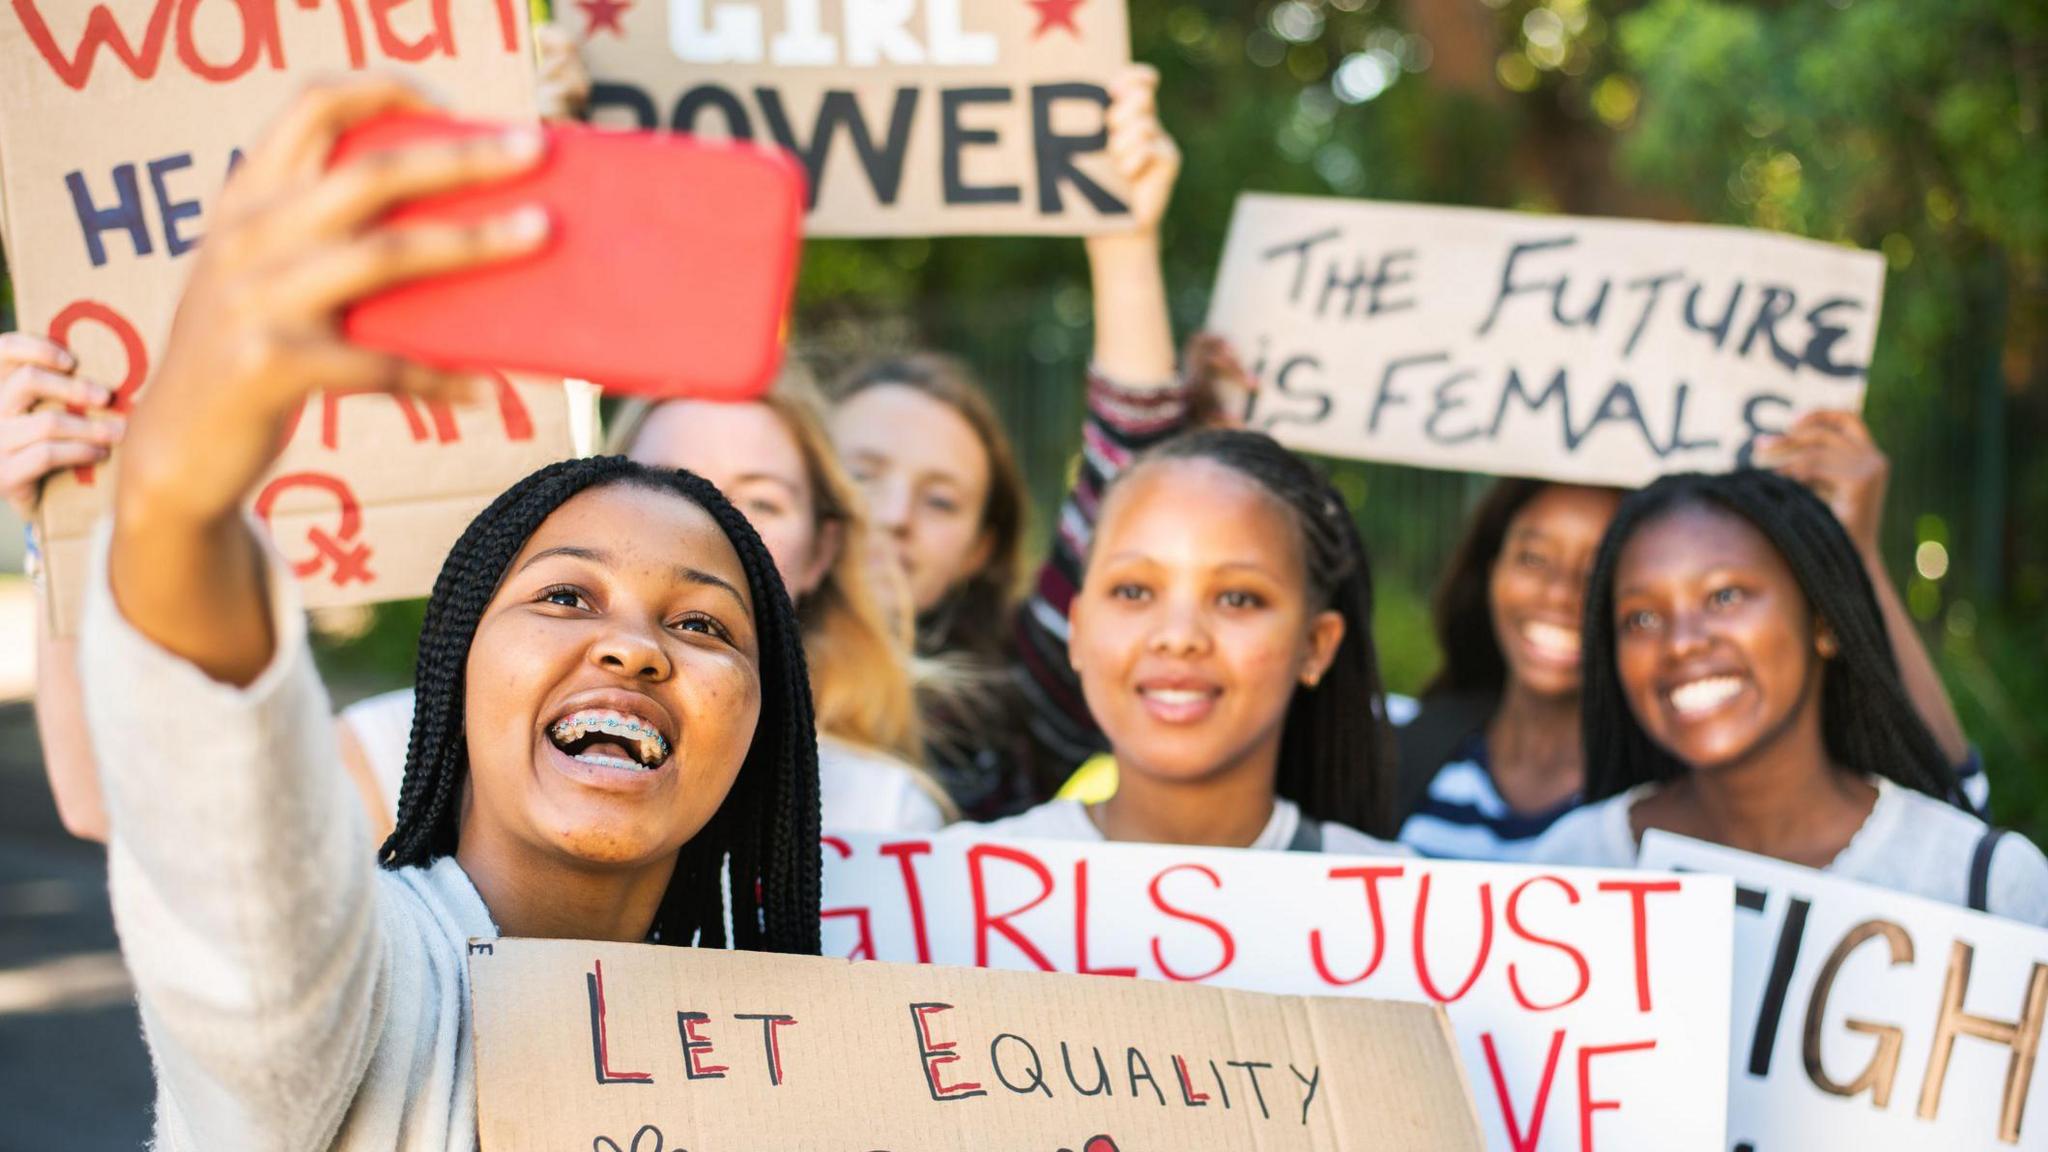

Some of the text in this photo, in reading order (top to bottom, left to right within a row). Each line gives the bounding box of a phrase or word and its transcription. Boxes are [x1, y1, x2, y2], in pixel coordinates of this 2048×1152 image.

[668, 0, 998, 65] GIRL
[1262, 228, 1868, 378] THE FUTURE
[1309, 866, 1682, 1013] JUST
[1735, 885, 2048, 1144] IGH
[586, 959, 1319, 1125] LET EQUALITY
